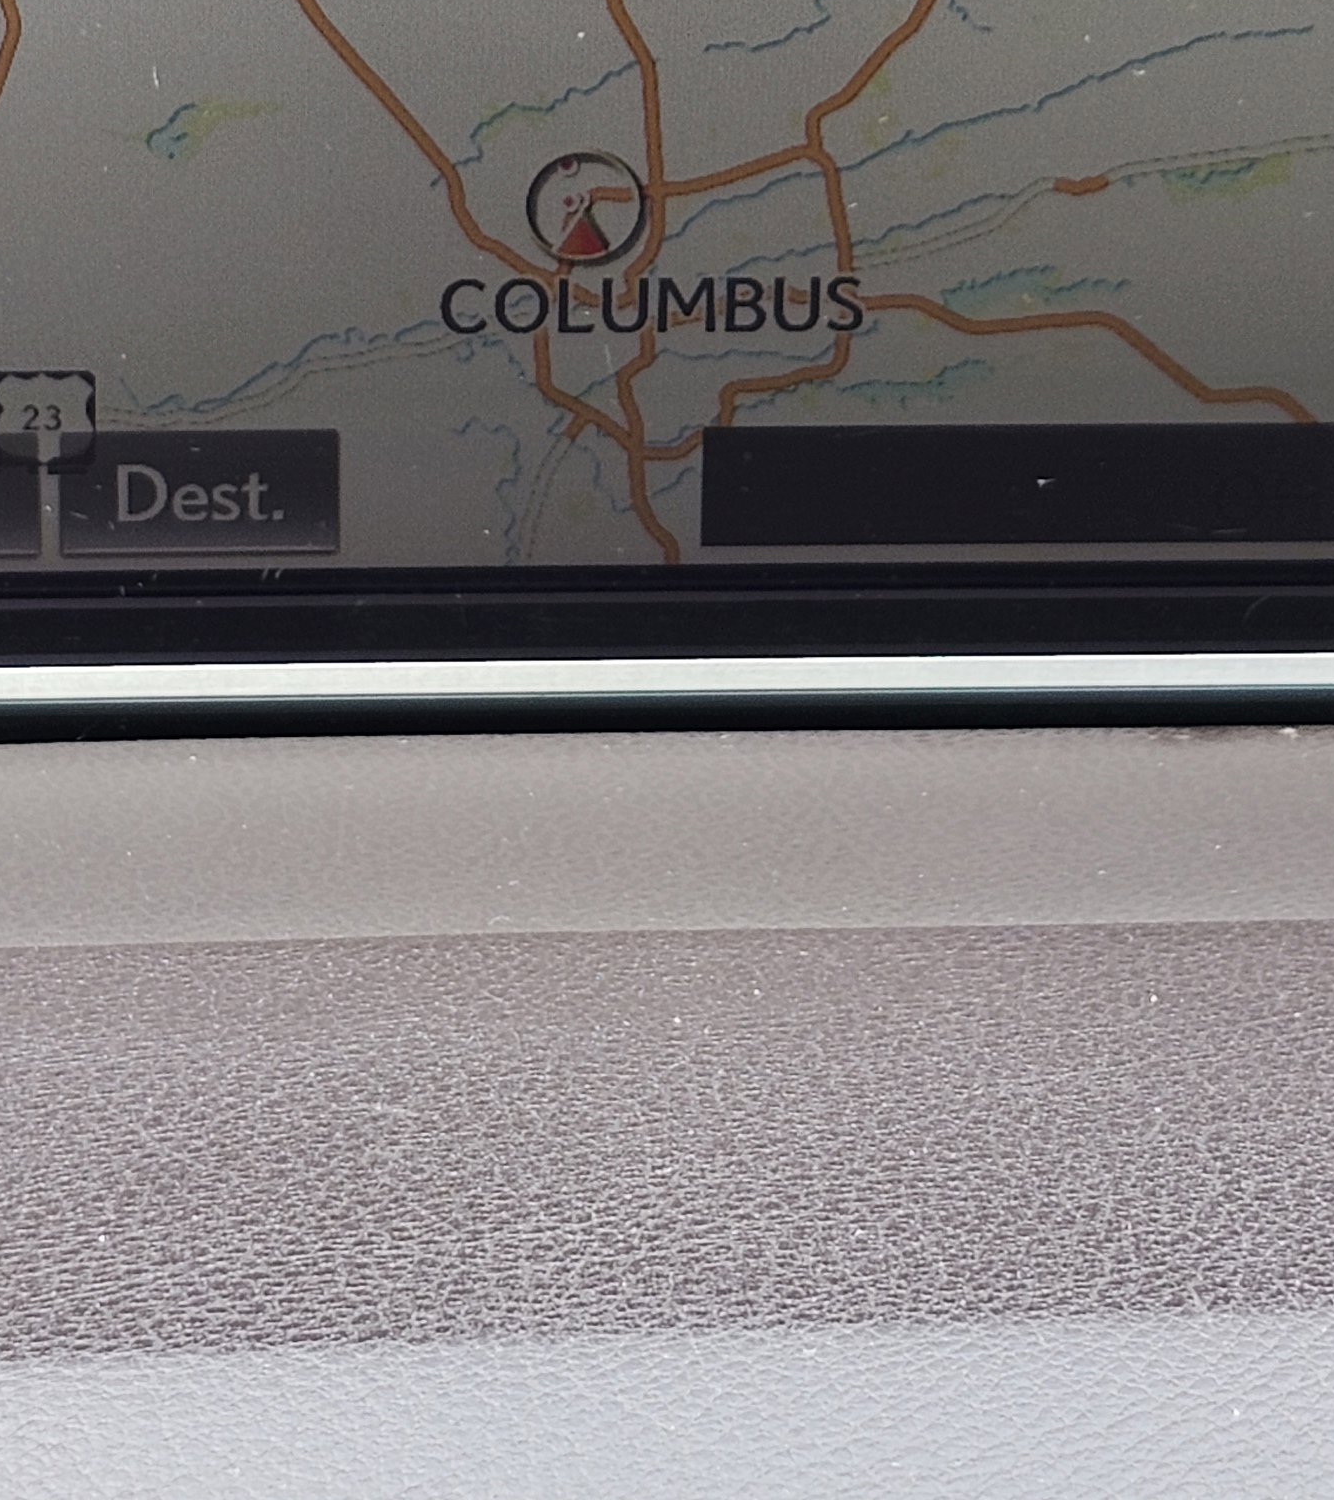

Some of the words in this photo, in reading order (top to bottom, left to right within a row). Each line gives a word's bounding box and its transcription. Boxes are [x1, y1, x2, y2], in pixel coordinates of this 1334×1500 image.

[439, 275, 864, 333] COLUMBUS
[21, 404, 63, 431] 23
[115, 463, 285, 524] Dest.
